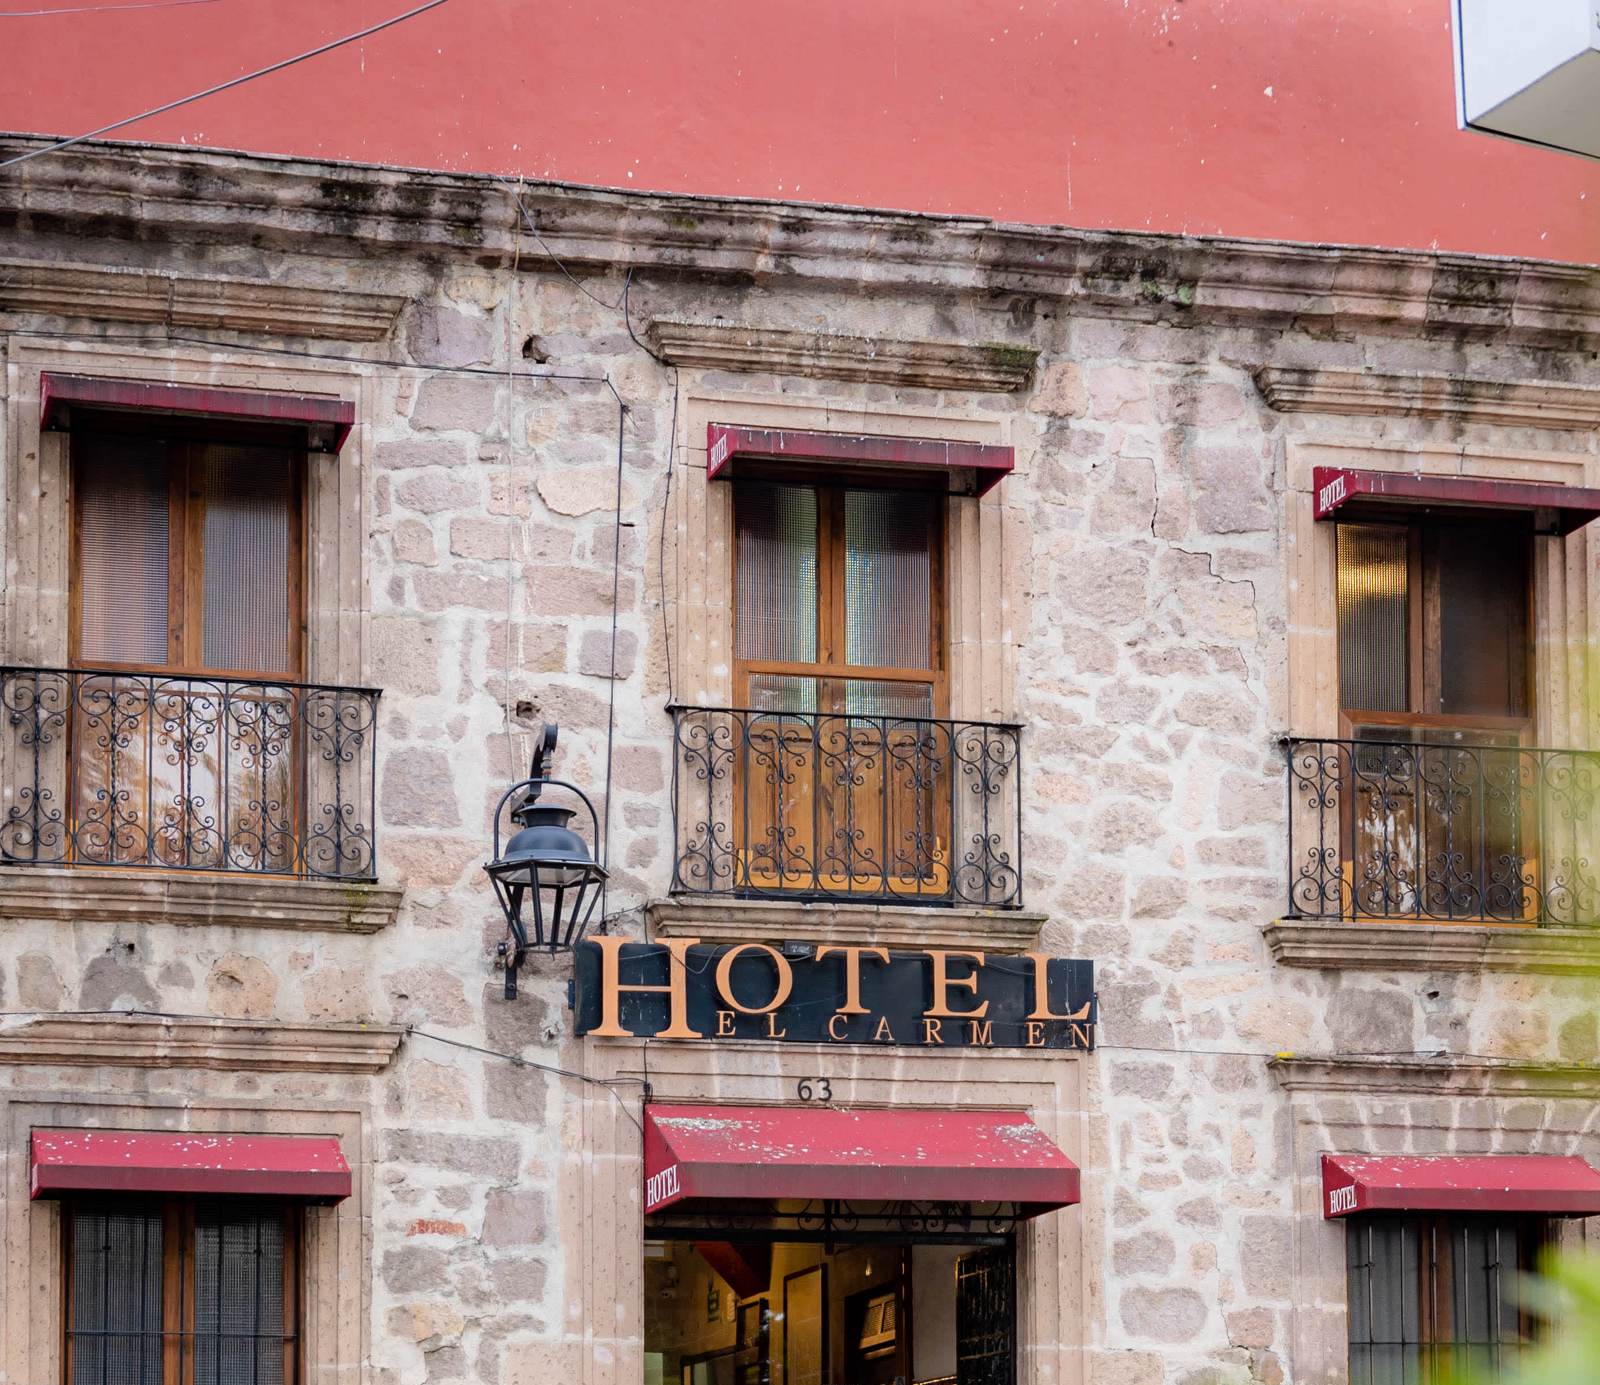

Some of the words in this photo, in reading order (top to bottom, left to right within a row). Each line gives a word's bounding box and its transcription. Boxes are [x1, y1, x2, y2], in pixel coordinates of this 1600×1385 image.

[1320, 475, 1347, 512] HOTEL
[585, 936, 1091, 1038] HOTEL
[716, 1011, 786, 1038] EL
[828, 1015, 1091, 1048] CARMEN
[798, 1078, 832, 1101] 63
[647, 1164, 680, 1208] HOTEL
[1330, 1185, 1357, 1213] HOTEL
